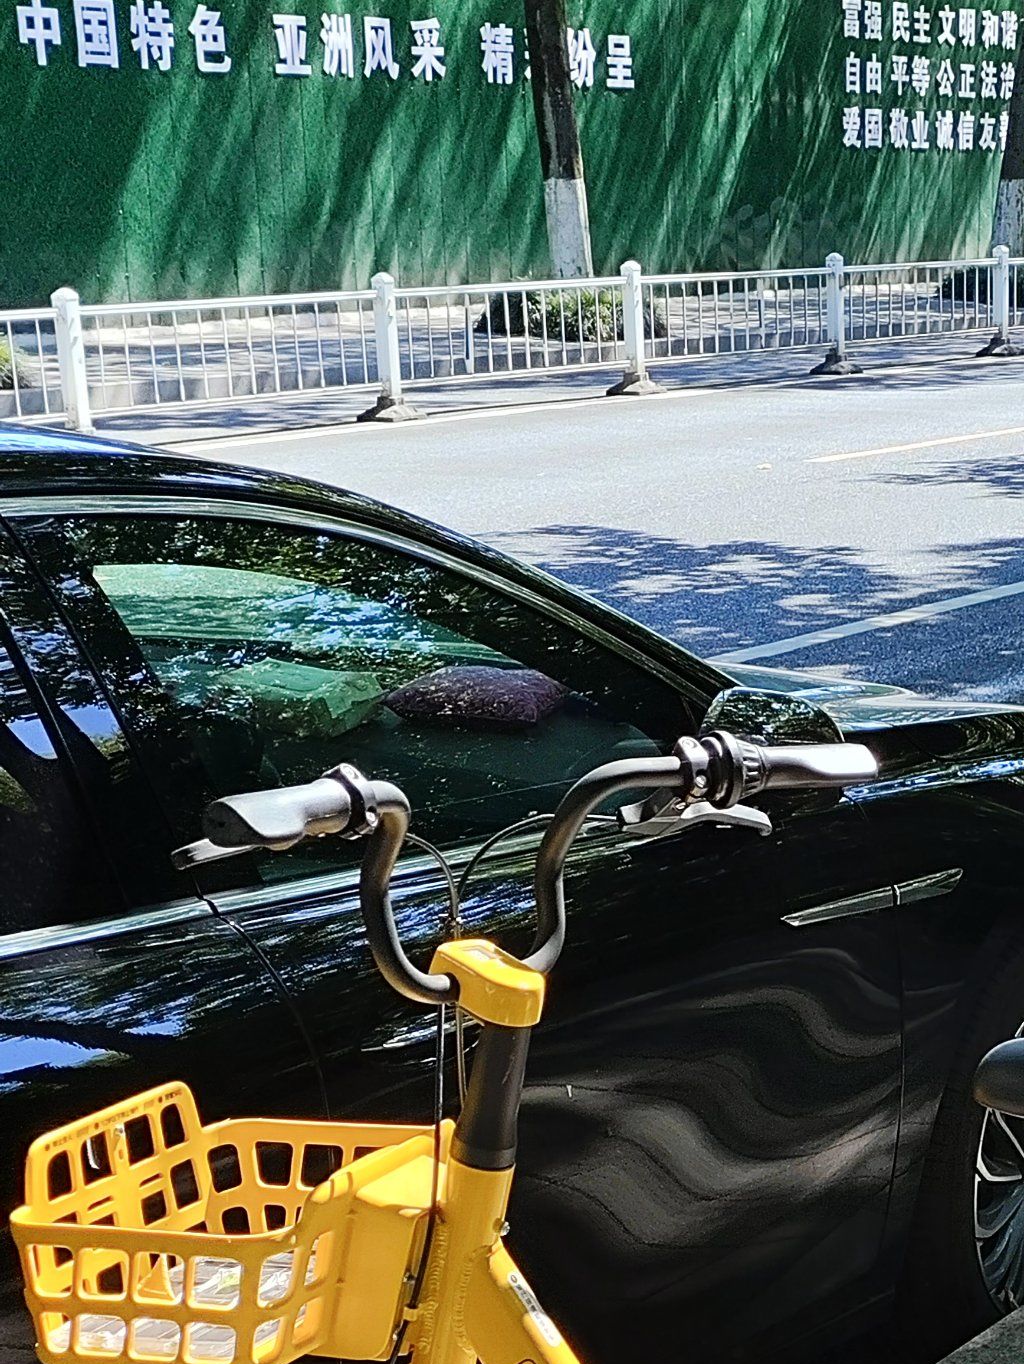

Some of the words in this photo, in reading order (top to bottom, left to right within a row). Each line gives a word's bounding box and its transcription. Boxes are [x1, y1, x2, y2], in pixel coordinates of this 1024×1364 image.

[16, 0, 232, 72] 中国特色
[272, 13, 447, 82] 亚洲风采
[480, 22, 635, 89] 精纷呈
[842, 0, 883, 41] 富强
[892, 1, 932, 44] 民主
[937, 4, 977, 47] 文明
[981, 10, 1018, 50] 和谐
[845, 51, 882, 95] 自由
[890, 55, 930, 97] 平等
[936, 59, 976, 99] 公正
[980, 60, 1016, 100] 法治
[842, 106, 883, 149] 爱国
[889, 108, 929, 149] 敬业
[935, 110, 975, 151] 诚信
